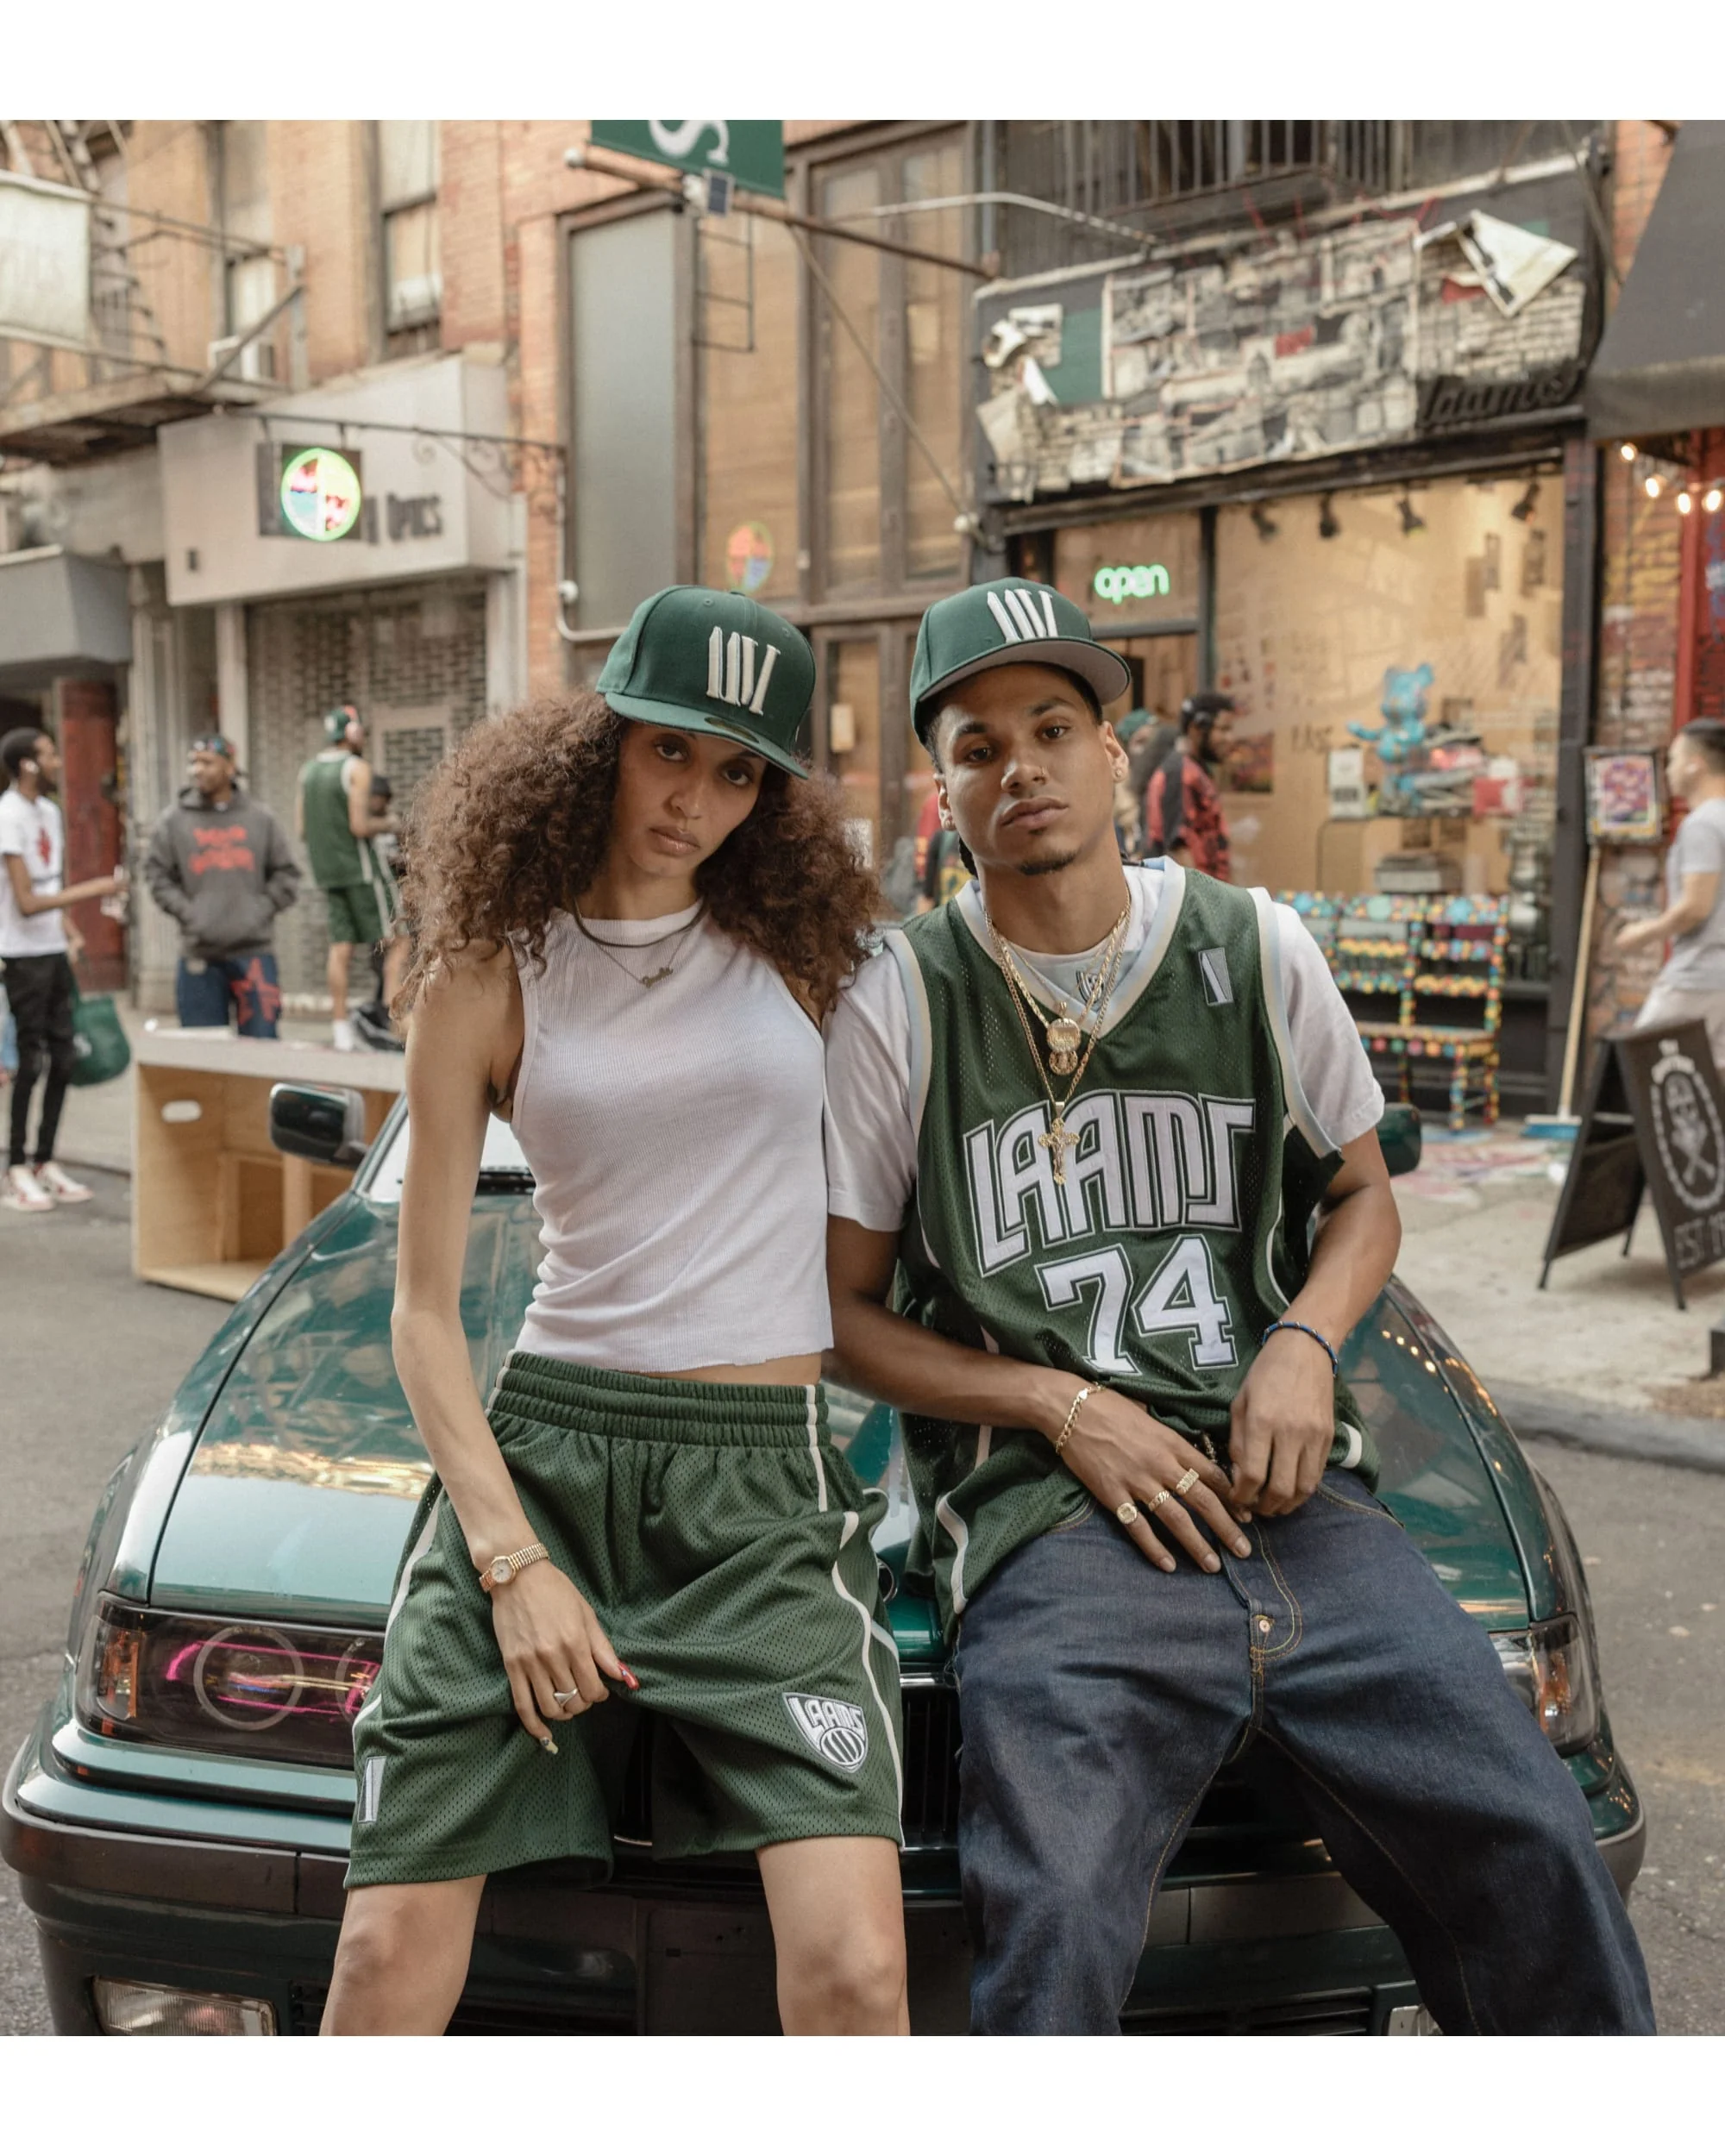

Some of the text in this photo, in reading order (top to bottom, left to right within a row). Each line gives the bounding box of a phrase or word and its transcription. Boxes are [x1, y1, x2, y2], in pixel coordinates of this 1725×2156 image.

[1094, 563, 1170, 605] open
[963, 1088, 1256, 1278] LAAMS
[1034, 1233, 1239, 1376] 74
[788, 1697, 866, 1751] LAAMS
